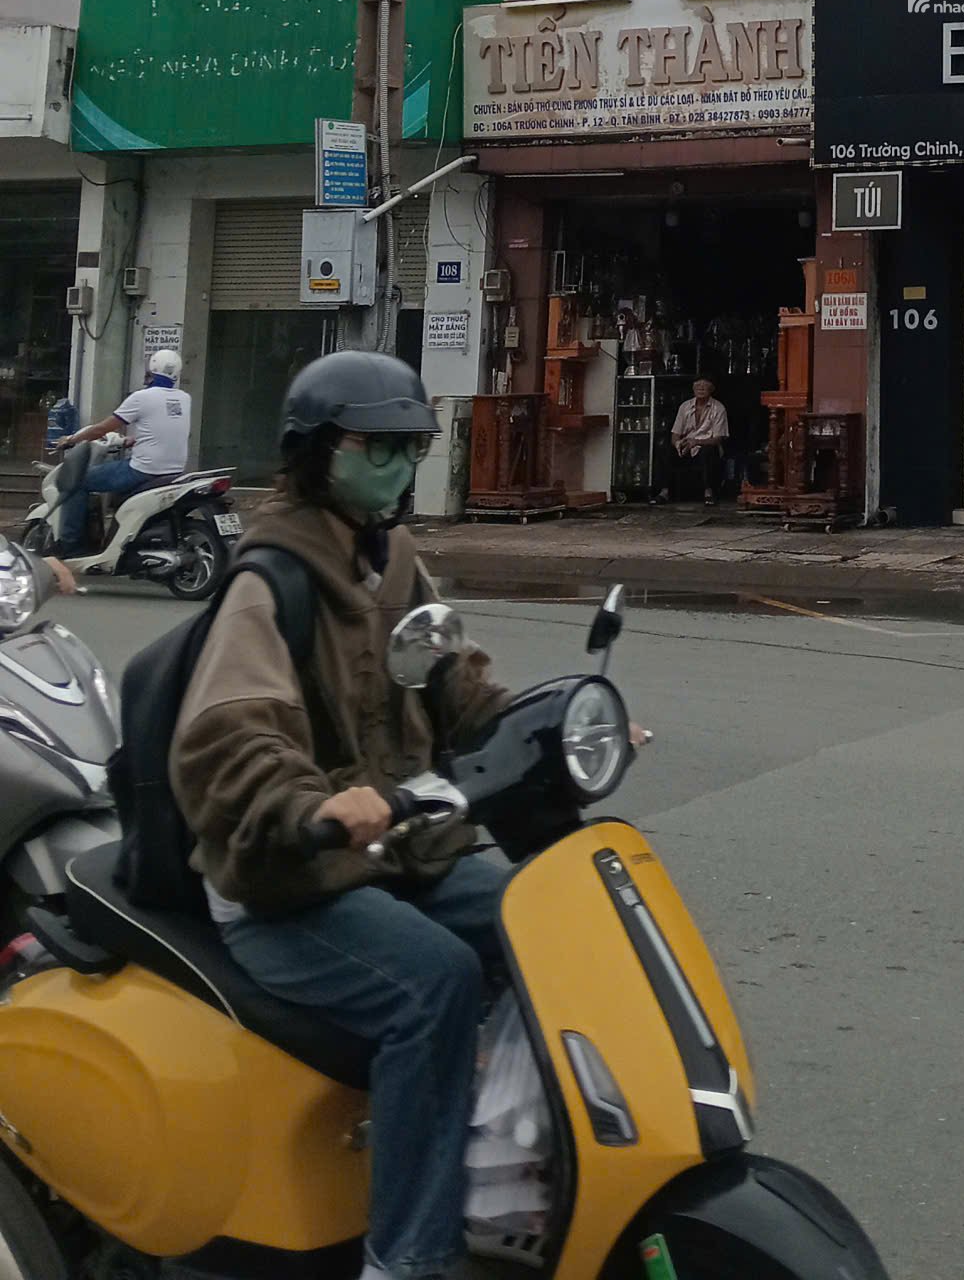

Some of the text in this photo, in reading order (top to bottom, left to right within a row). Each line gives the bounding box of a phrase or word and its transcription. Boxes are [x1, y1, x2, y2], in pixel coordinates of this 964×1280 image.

[480, 7, 603, 95] TIẾN
[616, 5, 806, 89] THÀNH
[629, 96, 635, 107] &
[754, 89, 772, 101] THEO
[492, 121, 513, 131] 106A
[549, 118, 574, 128] CHINH
[593, 117, 603, 127] 12
[830, 144, 856, 159] 106
[859, 141, 911, 161] Trường
[914, 140, 963, 158] Chinh,
[853, 180, 882, 219] TÚI
[440, 264, 458, 276] 108
[889, 308, 938, 330] 106
